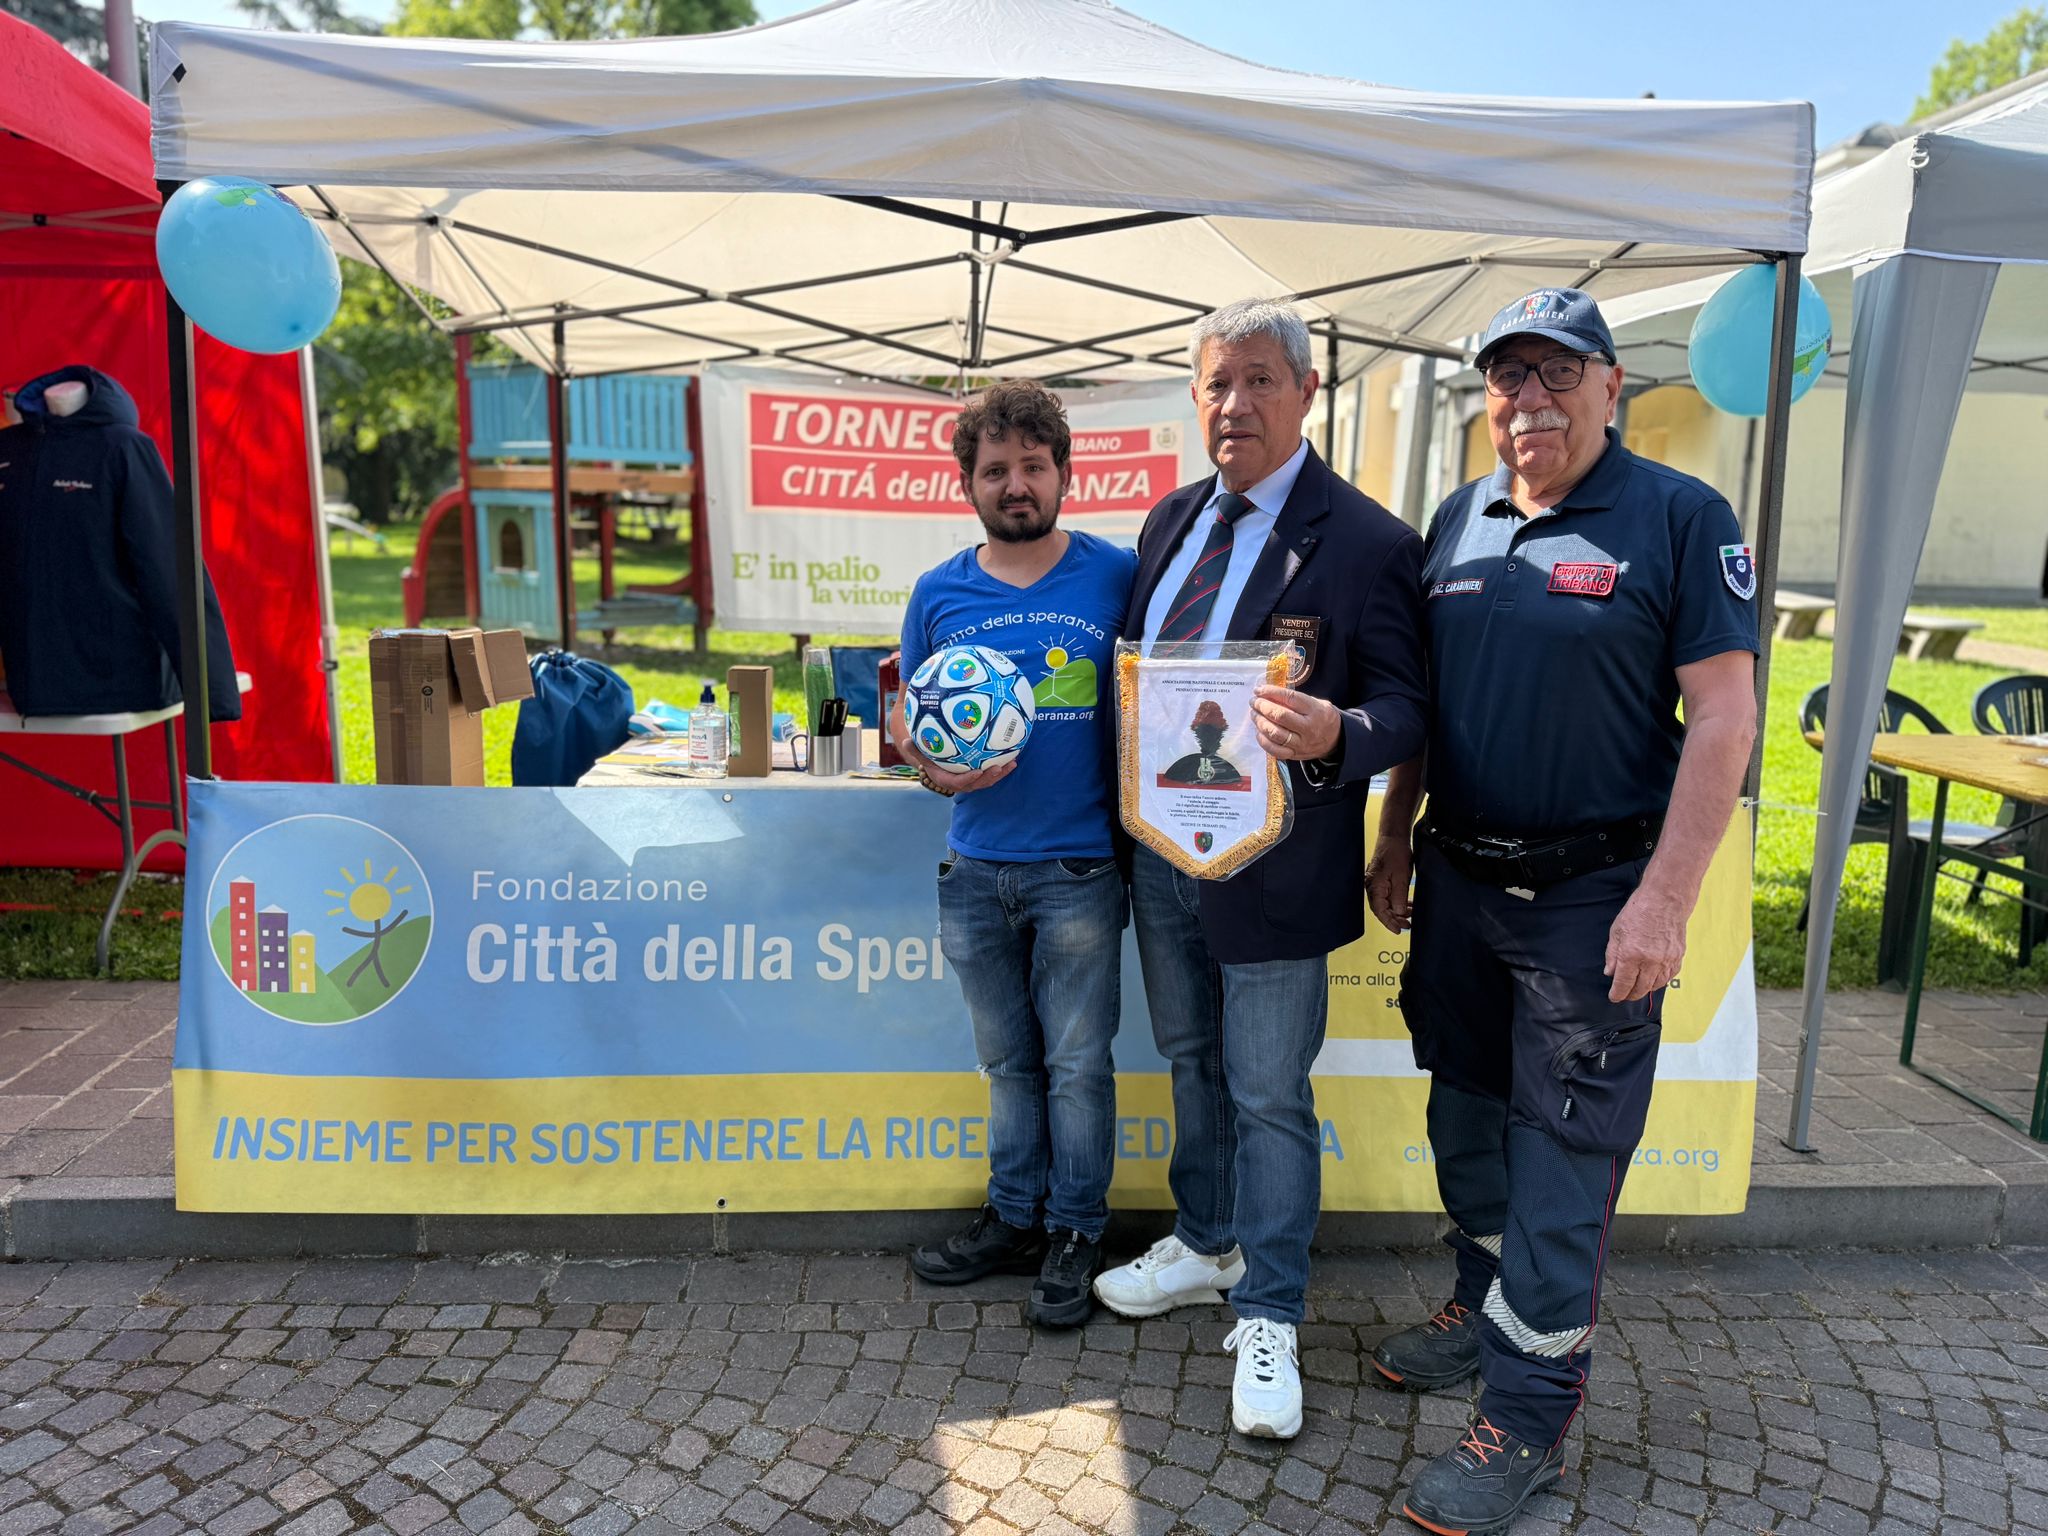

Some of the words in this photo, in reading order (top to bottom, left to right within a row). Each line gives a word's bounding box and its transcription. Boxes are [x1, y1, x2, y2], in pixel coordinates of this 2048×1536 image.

[1071, 436, 1122, 453] IBANO
[781, 462, 878, 500] CITTÁ
[1062, 469, 1151, 502] ANZA
[768, 554, 799, 581] in
[805, 556, 881, 587] palio
[1555, 566, 1598, 578] GRUPPO
[1601, 568, 1613, 579] DI
[1445, 580, 1483, 593] CARABINIERI
[1554, 578, 1608, 591] TRIBANO
[811, 583, 832, 604] la
[837, 585, 911, 607] vittori
[982, 613, 1024, 630] della
[1027, 612, 1105, 641] speranza
[1274, 627, 1304, 638] PRESIDENTE
[1281, 618, 1311, 629] VENETO
[1034, 710, 1095, 721] eranza.org
[471, 870, 709, 902] Fondazione
[466, 921, 618, 984] Città
[643, 923, 793, 982] della
[1329, 974, 1361, 986] rma
[1366, 972, 1396, 986] alla
[212, 1116, 413, 1164] INSIEME
[426, 1121, 517, 1164] PER
[530, 1117, 805, 1165] SOSTENERE
[816, 1117, 872, 1160] LA
[885, 1116, 996, 1160] RICE
